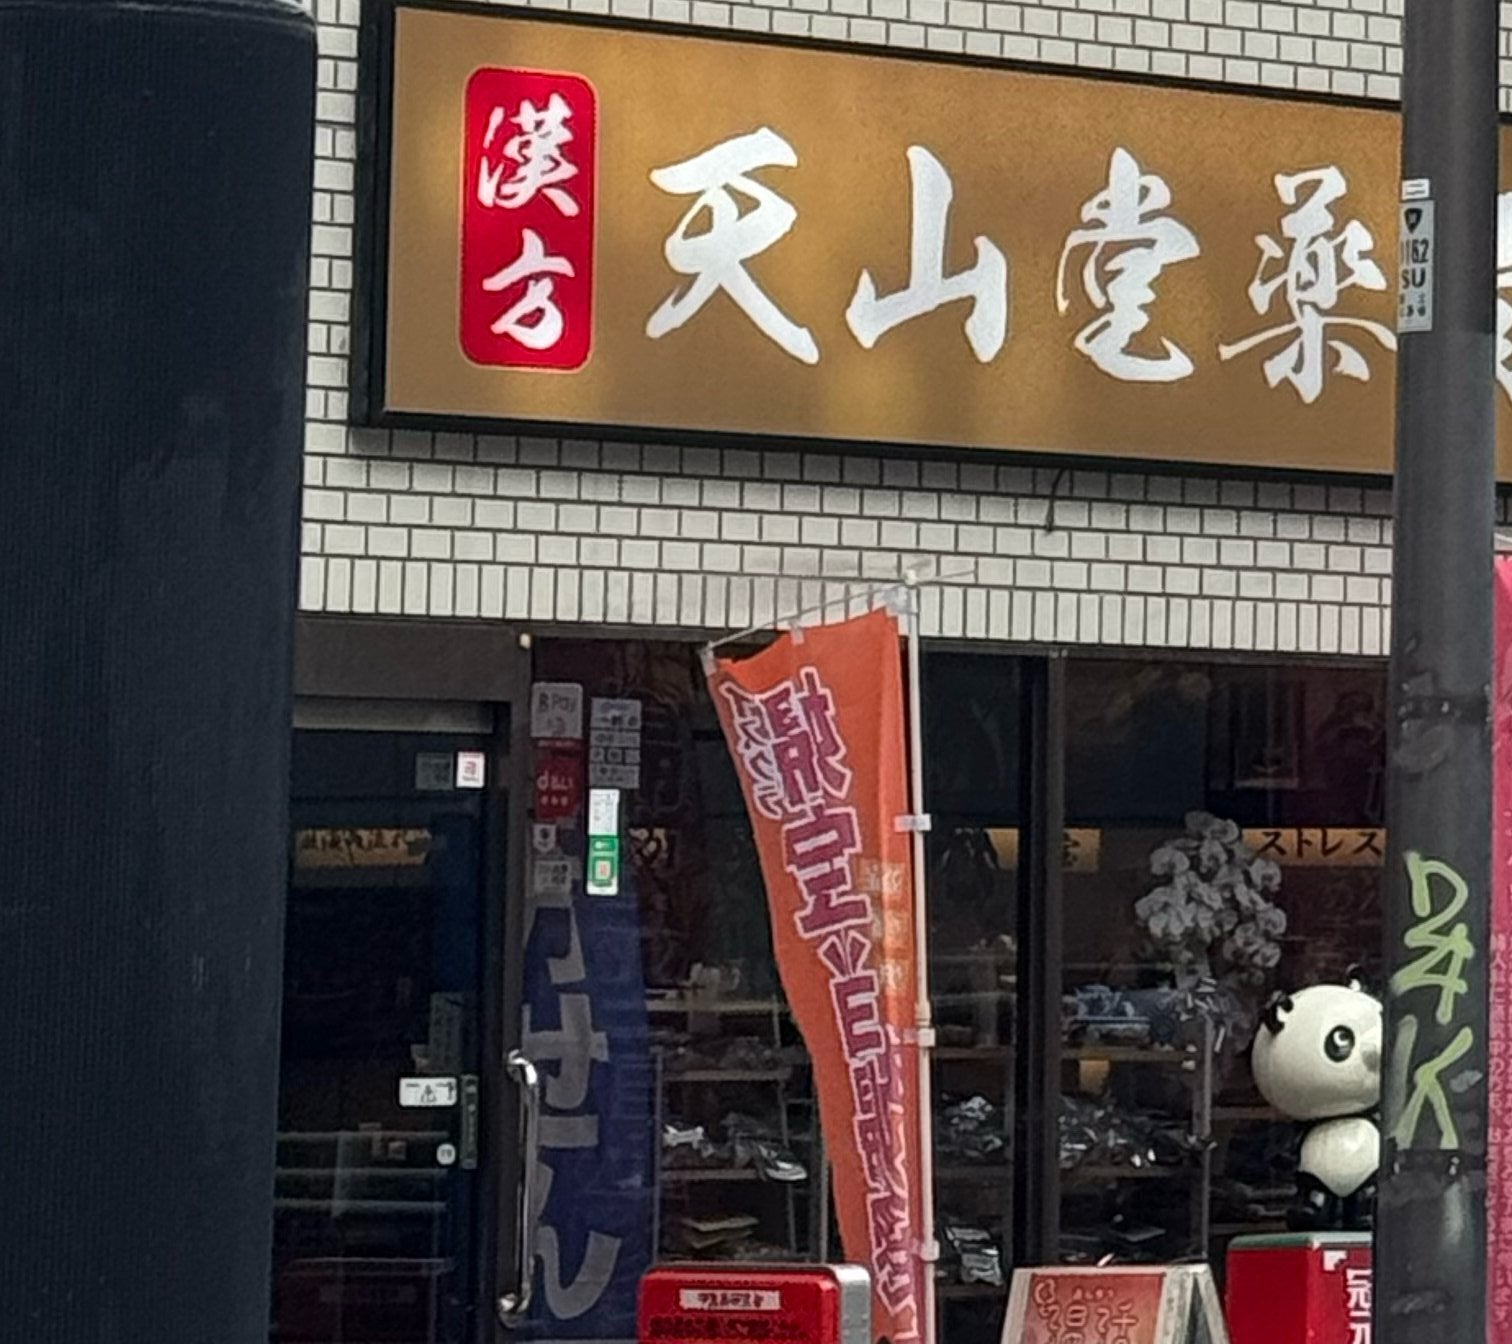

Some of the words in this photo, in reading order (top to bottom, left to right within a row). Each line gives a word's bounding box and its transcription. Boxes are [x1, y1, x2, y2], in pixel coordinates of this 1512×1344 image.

[476, 92, 581, 350] 漢方
[1260, 828, 1384, 857] ストレス
